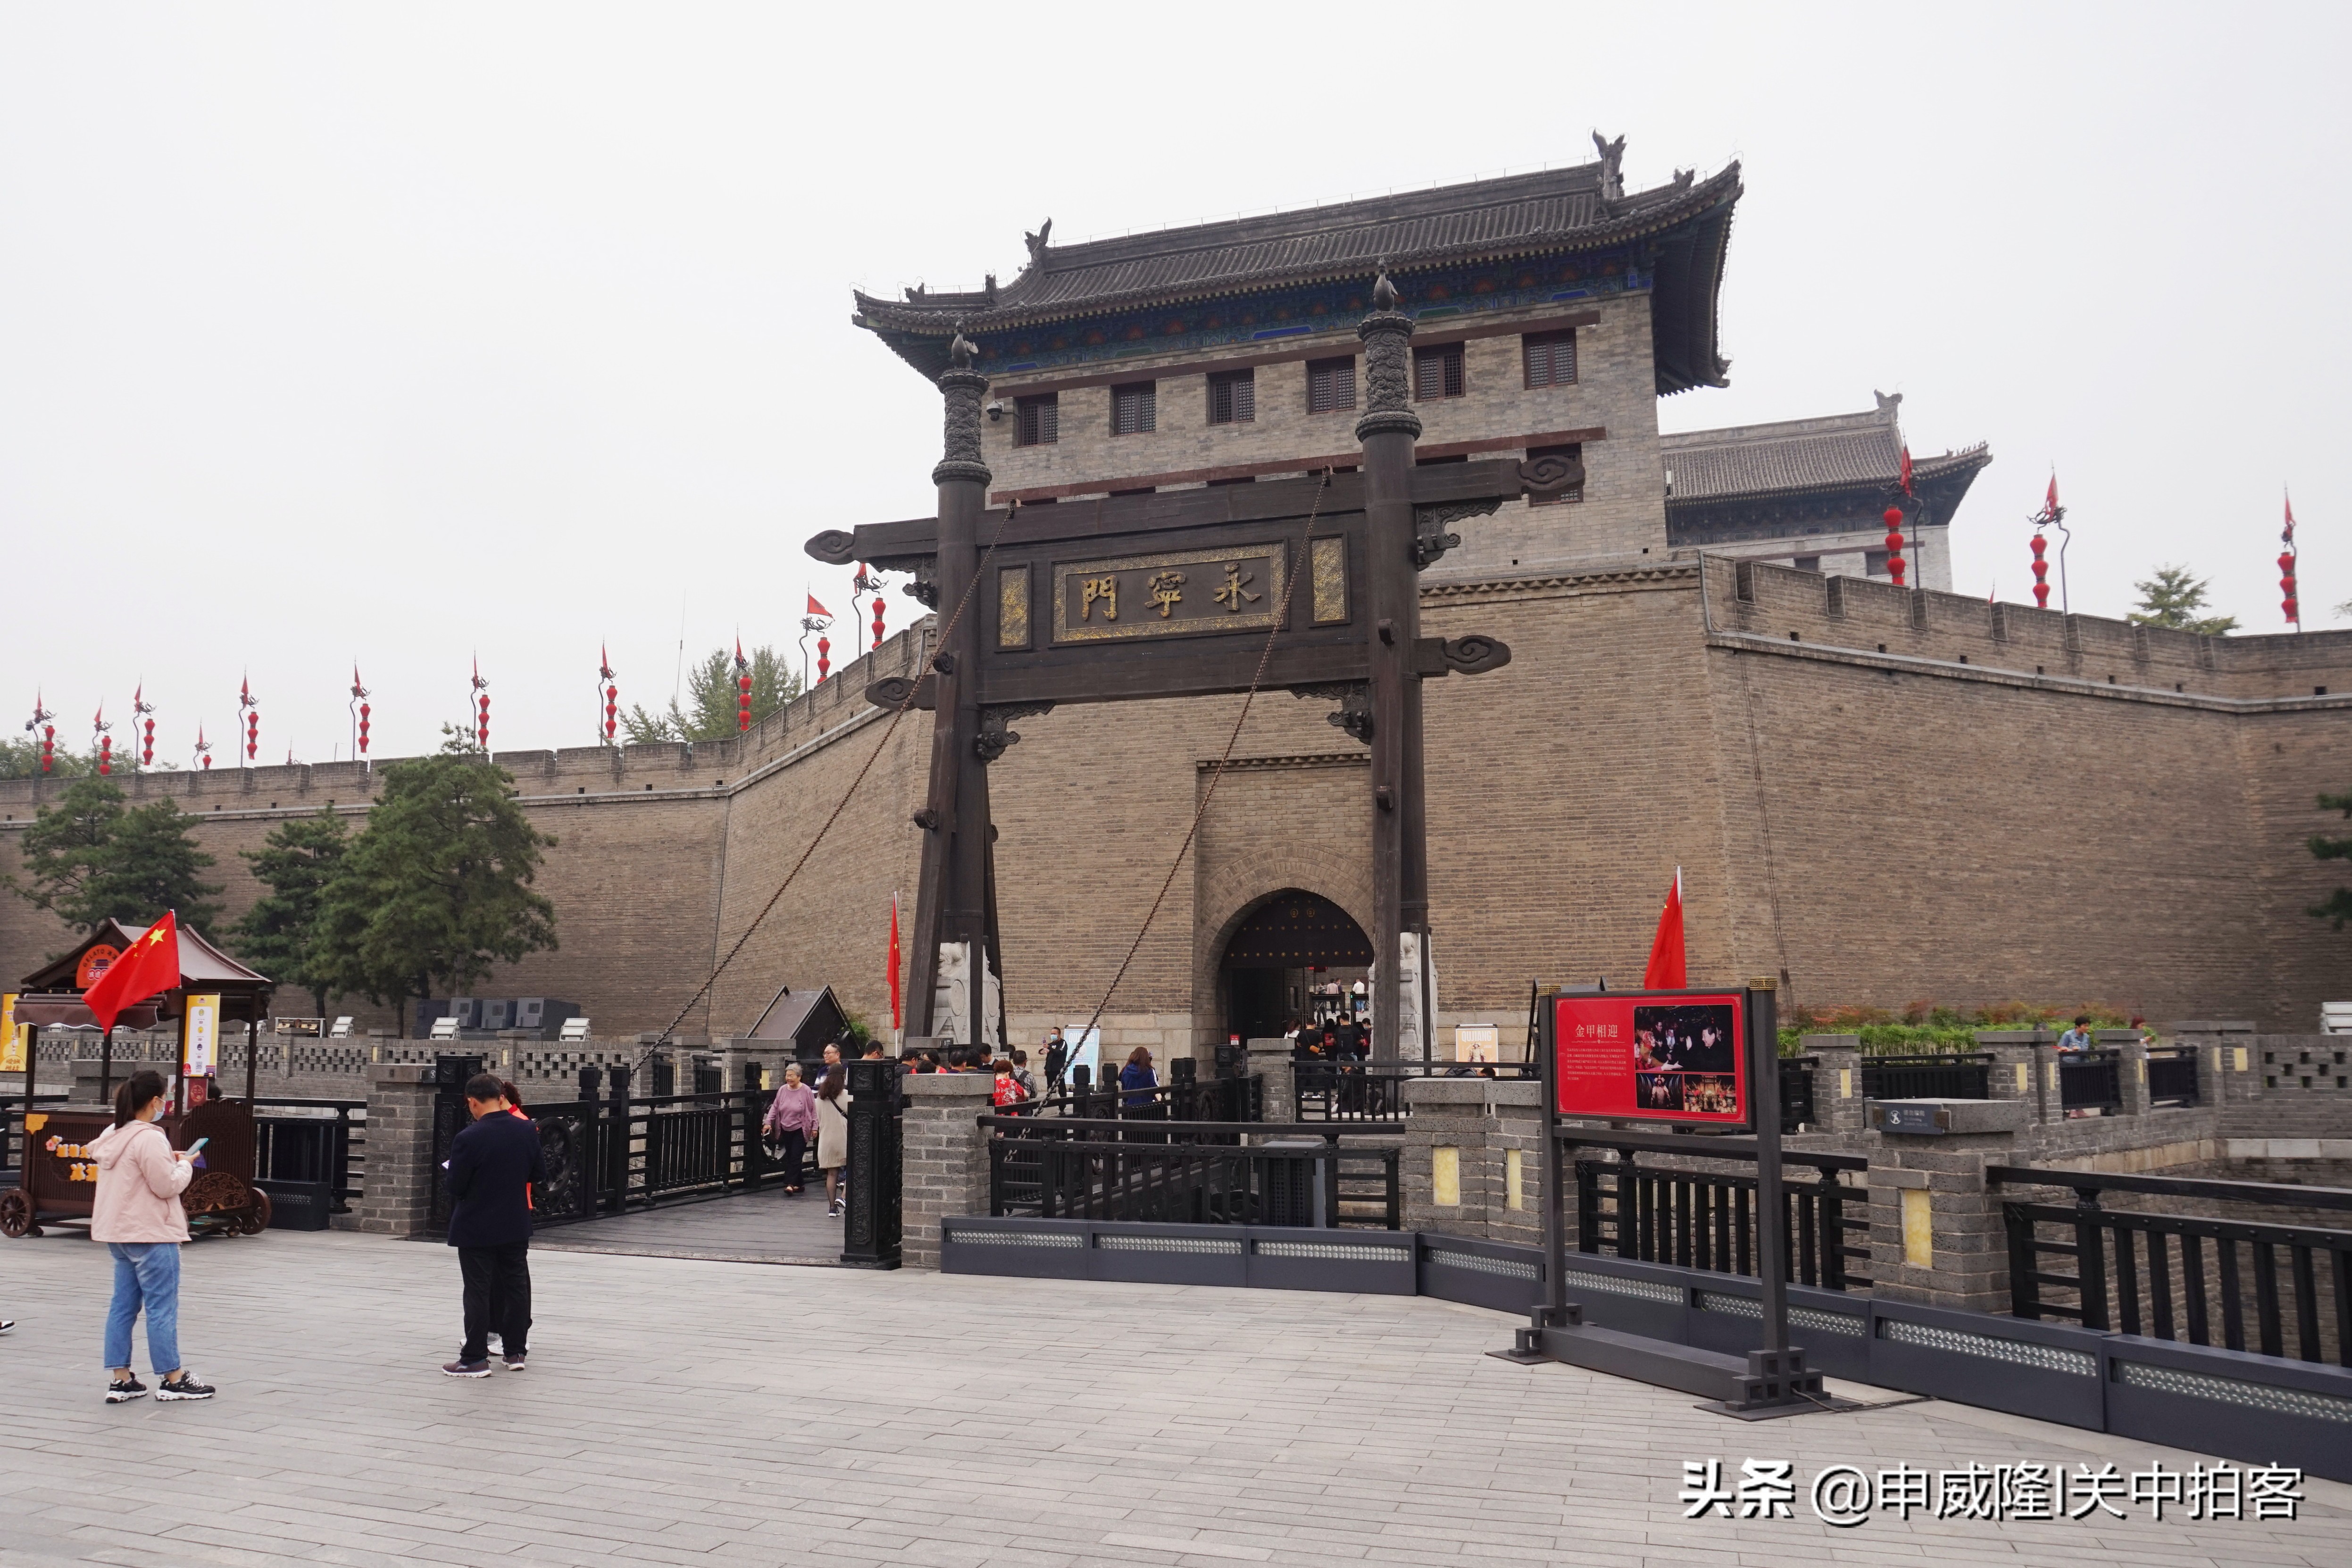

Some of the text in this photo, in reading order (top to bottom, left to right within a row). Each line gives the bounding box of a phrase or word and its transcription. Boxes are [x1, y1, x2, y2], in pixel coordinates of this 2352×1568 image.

[83, 949, 105, 967] GELATO
[1461, 1031, 1492, 1043] QUJIANG
[1575, 1024, 1618, 1038] 金甲相迎
